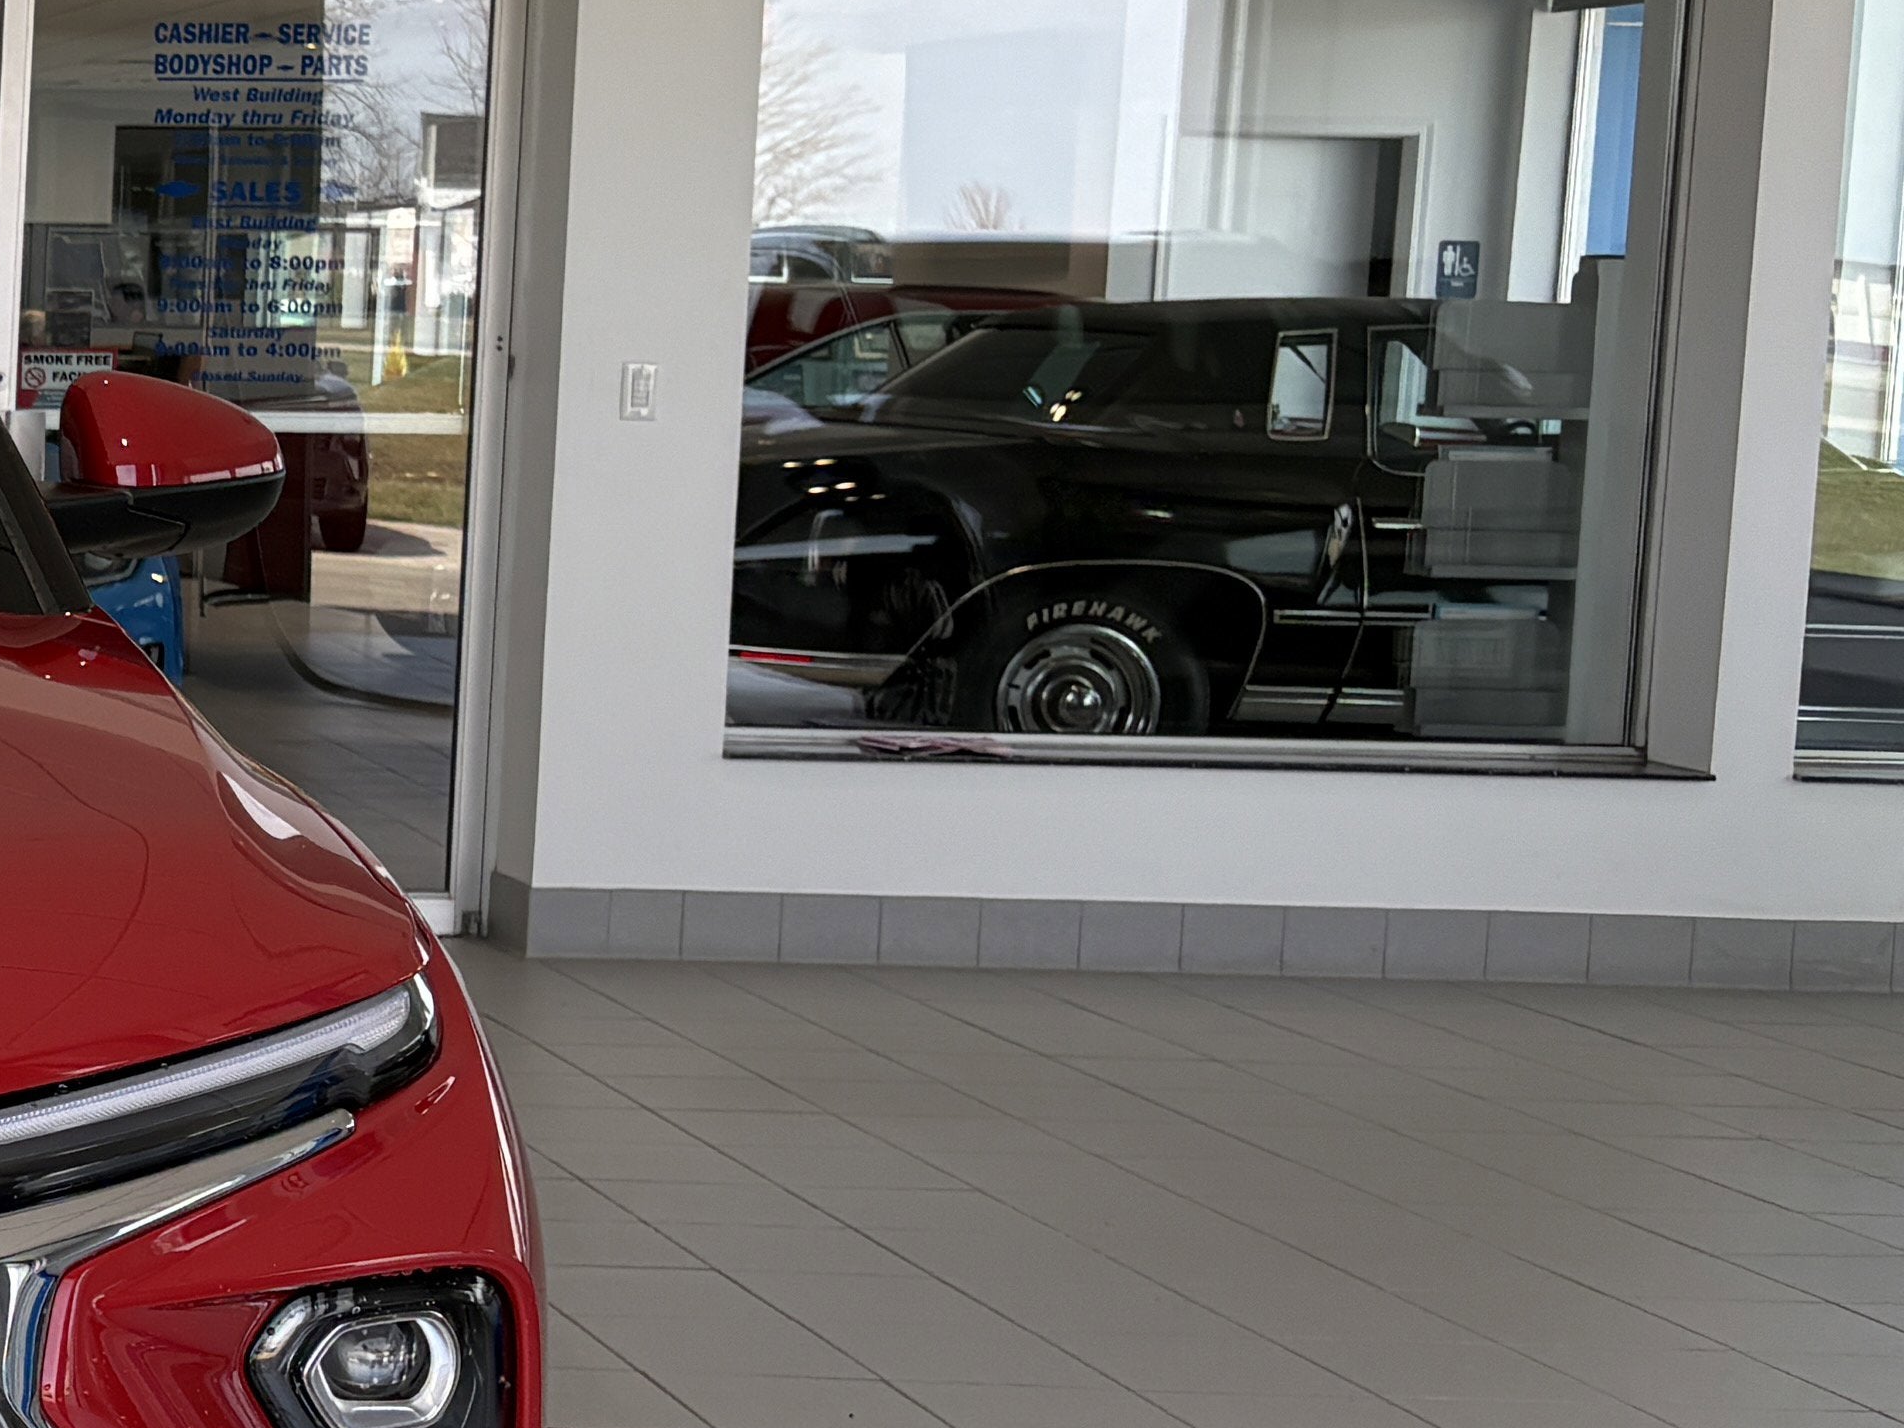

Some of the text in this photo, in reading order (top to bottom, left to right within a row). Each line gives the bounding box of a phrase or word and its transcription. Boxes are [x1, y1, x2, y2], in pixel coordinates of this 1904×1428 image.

[154, 23, 372, 45] CASHIER SERVICE
[154, 54, 369, 76] BODYSHOP PARTS
[193, 86, 323, 106] West Building
[154, 109, 354, 129] Monday thru Friday
[212, 181, 302, 202] SALES
[242, 217, 317, 231] Building
[269, 256, 345, 272] 8:00pm
[282, 279, 333, 294] Friday
[267, 298, 343, 317] 6:00pm
[24, 354, 111, 366] SMOKE FREE
[238, 342, 257, 356] to
[266, 341, 341, 360] 4:00pm
